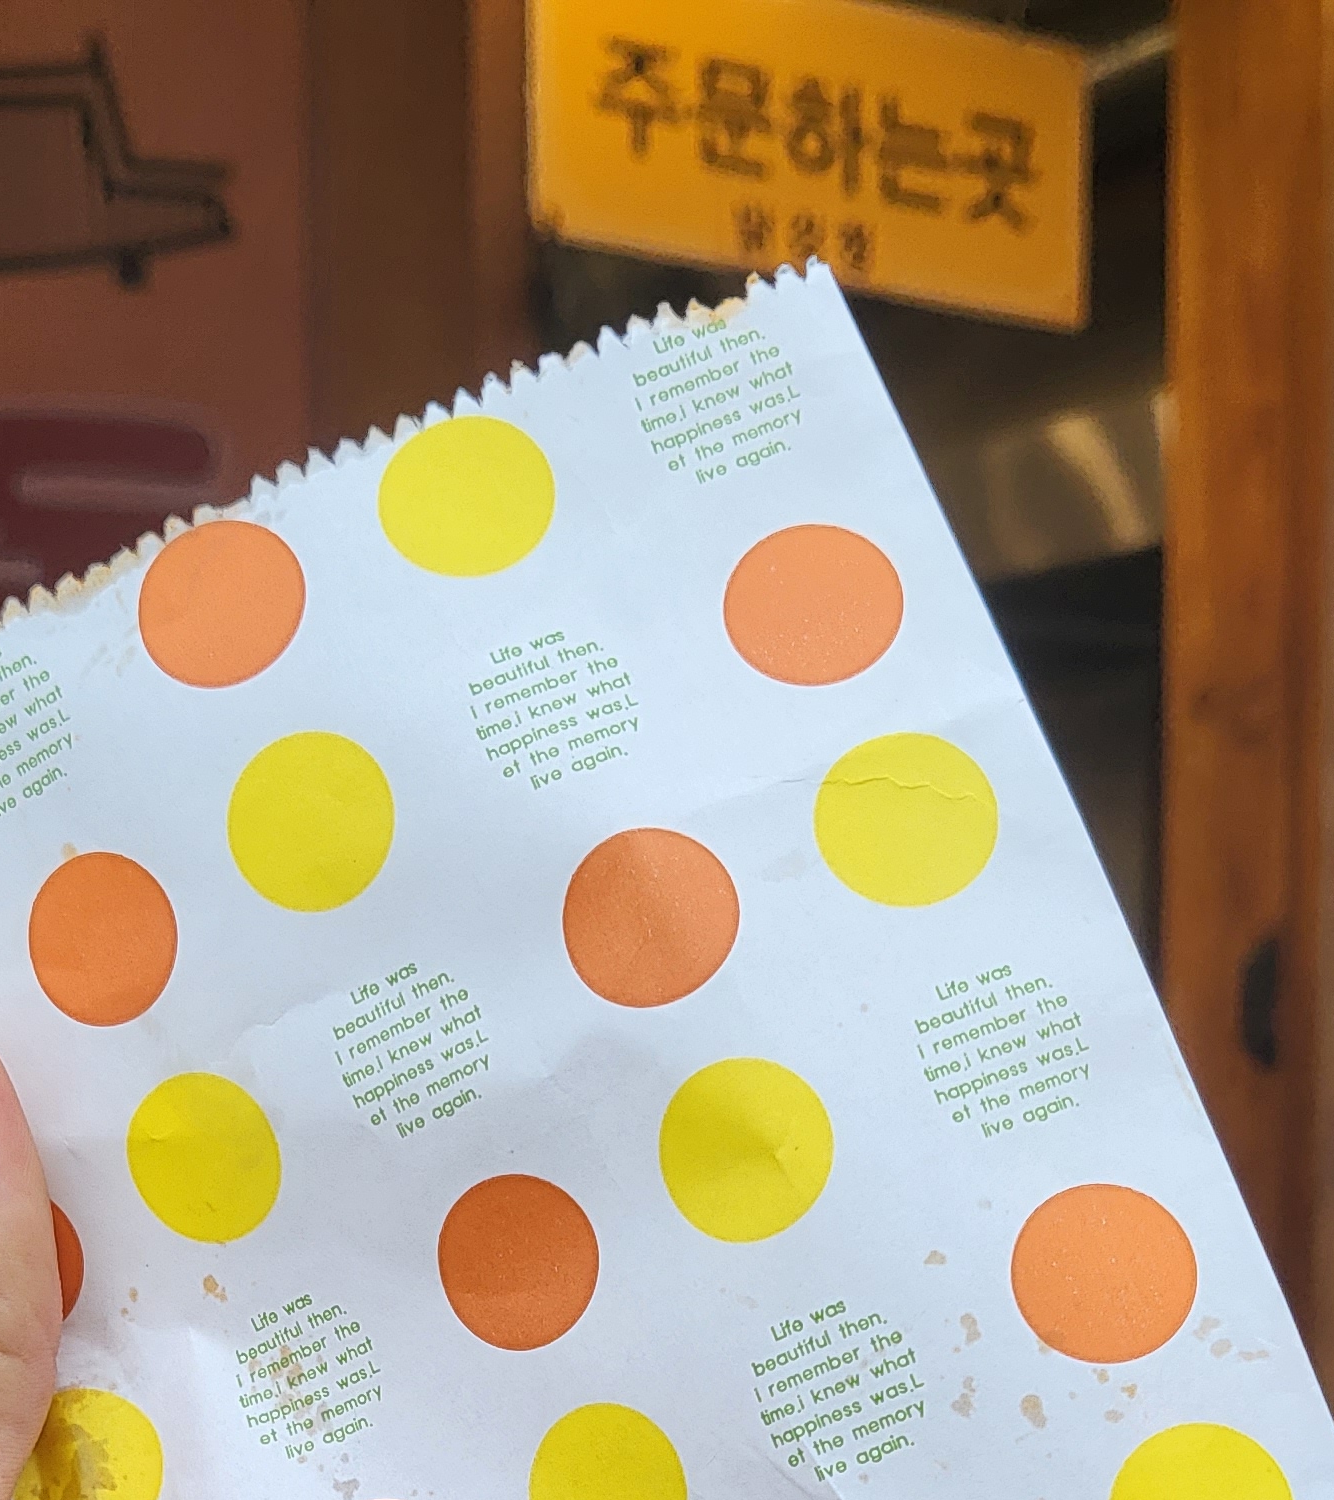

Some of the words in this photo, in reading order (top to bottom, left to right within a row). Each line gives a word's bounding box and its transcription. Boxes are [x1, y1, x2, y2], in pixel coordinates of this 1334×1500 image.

[632, 345, 713, 387] beautiful
[719, 330, 766, 353] then.
[652, 335, 686, 355] Life
[691, 318, 727, 340] was
[649, 360, 739, 407] remember
[749, 346, 780, 366] the
[691, 385, 740, 414] knew
[748, 361, 793, 390] what
[650, 410, 742, 455] happiness
[667, 453, 686, 472] et
[694, 441, 724, 462] the
[731, 408, 801, 446] memory
[695, 464, 727, 485] live
[735, 441, 792, 468] again.
[22, 670, 50, 692] the
[23, 684, 63, 717] what
[15, 732, 73, 777] memory
[22, 767, 68, 799] again.
[332, 991, 406, 1041] beautiful
[411, 972, 455, 1000] then.
[349, 983, 380, 1005] Life
[384, 962, 418, 987] was
[914, 991, 998, 1035] beautiful
[1004, 977, 1053, 1001] then.
[935, 980, 969, 1001] Life
[975, 964, 1012, 986] was
[348, 1006, 431, 1060] remember
[439, 988, 469, 1011] the
[386, 1032, 432, 1065] knew
[439, 1004, 482, 1037] what
[932, 1008, 1026, 1055] remember
[1036, 995, 1068, 1015] the
[976, 1034, 1027, 1064] knew
[1035, 1011, 1082, 1041] what
[352, 1058, 435, 1109] happiness
[370, 1106, 388, 1126] et
[392, 1092, 420, 1114] the
[425, 1053, 489, 1097] memory
[933, 1061, 1028, 1105] happiness
[951, 1103, 971, 1123] et
[979, 1094, 1011, 1113] the
[1018, 1063, 1089, 1100] memory
[395, 1116, 426, 1139] live
[431, 1088, 482, 1120] again.
[980, 1118, 1014, 1139] live
[1022, 1095, 1080, 1123] again.
[750, 1329, 832, 1378] beautiful
[838, 1313, 888, 1339] then.
[770, 1319, 804, 1342] Life
[809, 1300, 847, 1325] was
[767, 1346, 860, 1398] remember
[869, 1330, 903, 1353] the
[809, 1373, 860, 1405] knew
[869, 1347, 916, 1379] what
[770, 1401, 863, 1449] happiness
[787, 1447, 806, 1468] et
[812, 1435, 844, 1456] the
[851, 1400, 924, 1441] memory
[813, 1460, 847, 1483] live
[855, 1434, 915, 1465] again.
